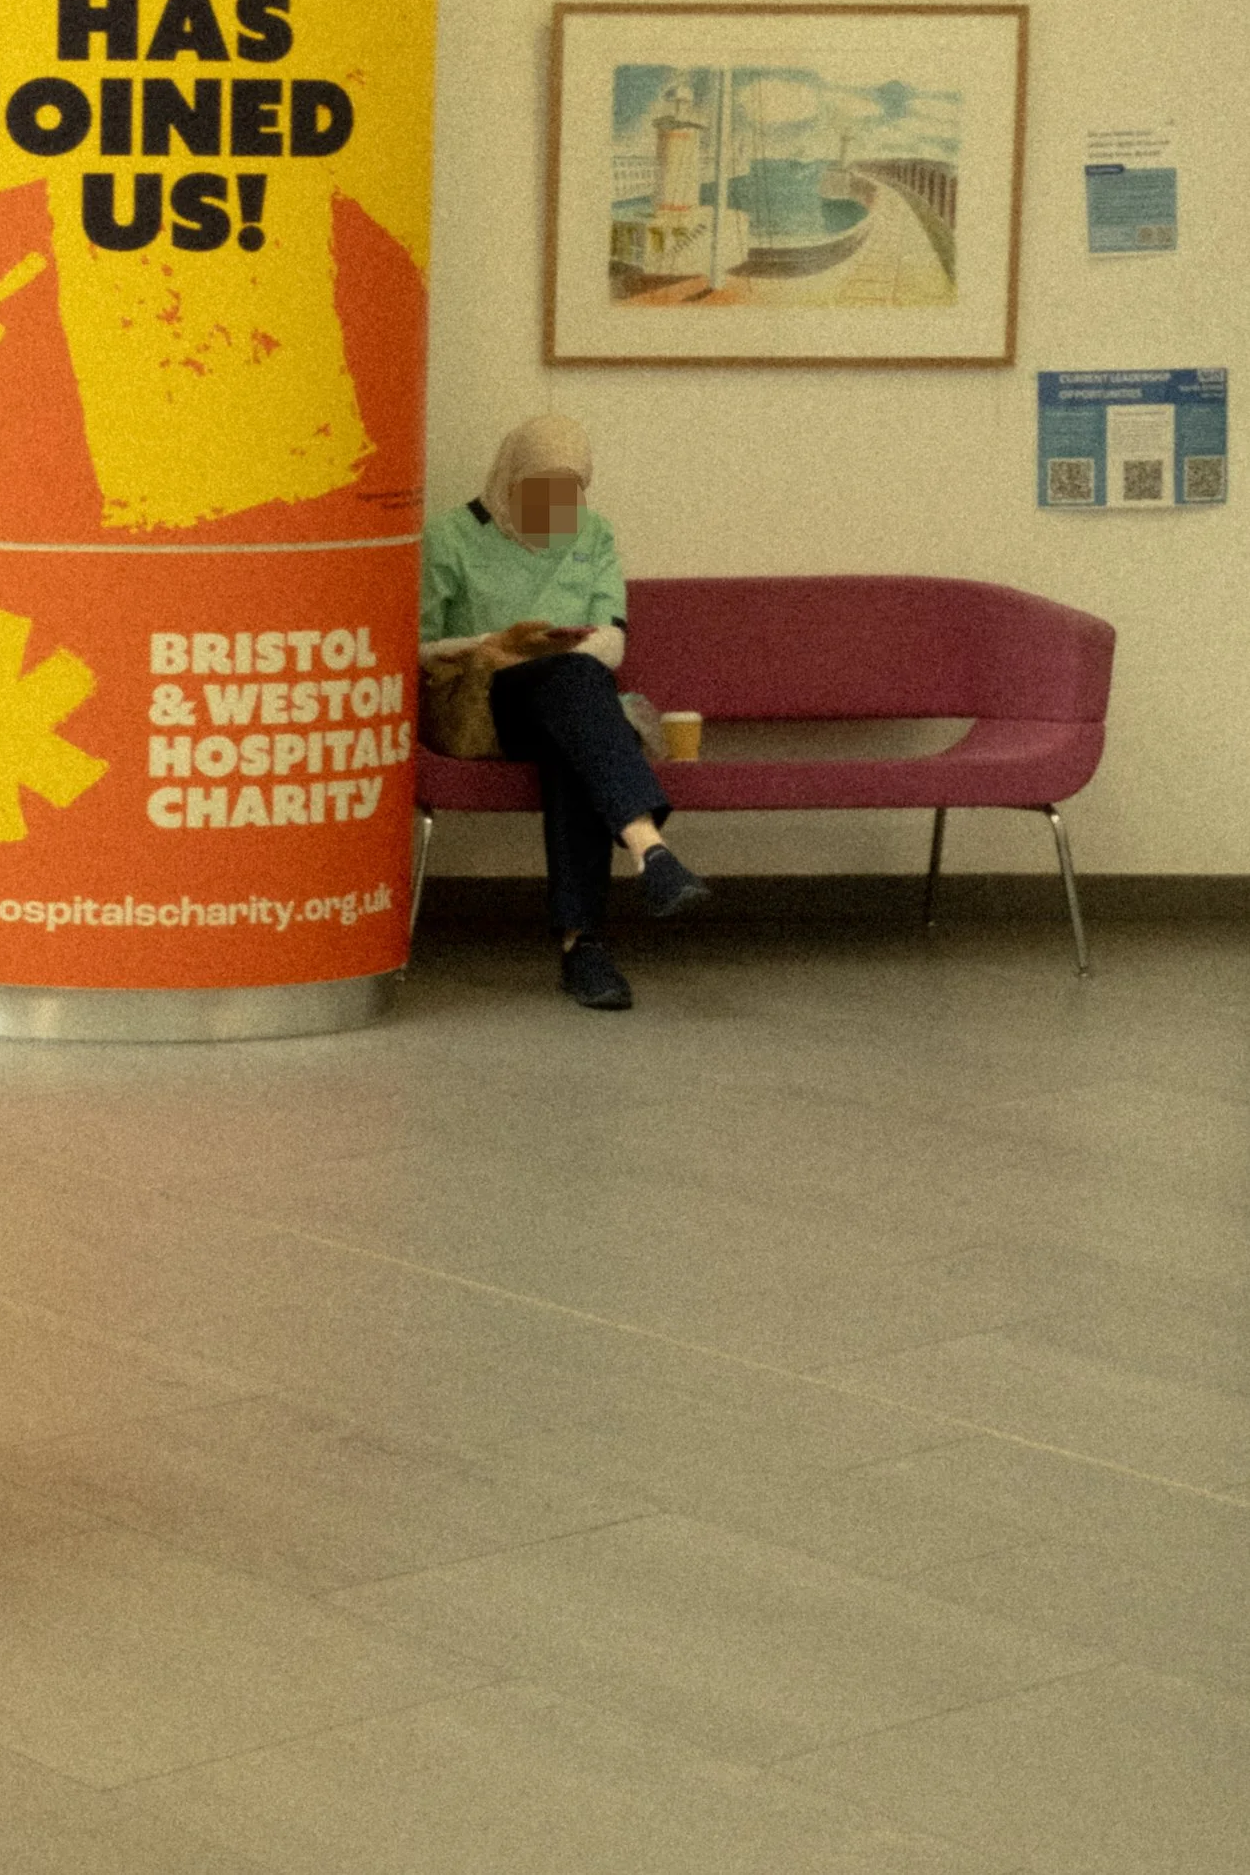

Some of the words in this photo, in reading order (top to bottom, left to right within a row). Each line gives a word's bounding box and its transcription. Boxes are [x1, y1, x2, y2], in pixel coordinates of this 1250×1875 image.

[82, 171, 268, 252] US!
[150, 627, 377, 675] BRISTOL
[148, 682, 197, 726] &
[202, 673, 404, 726] WESTON
[148, 720, 412, 779] HOSPITALS
[146, 775, 384, 829] CHARITY
